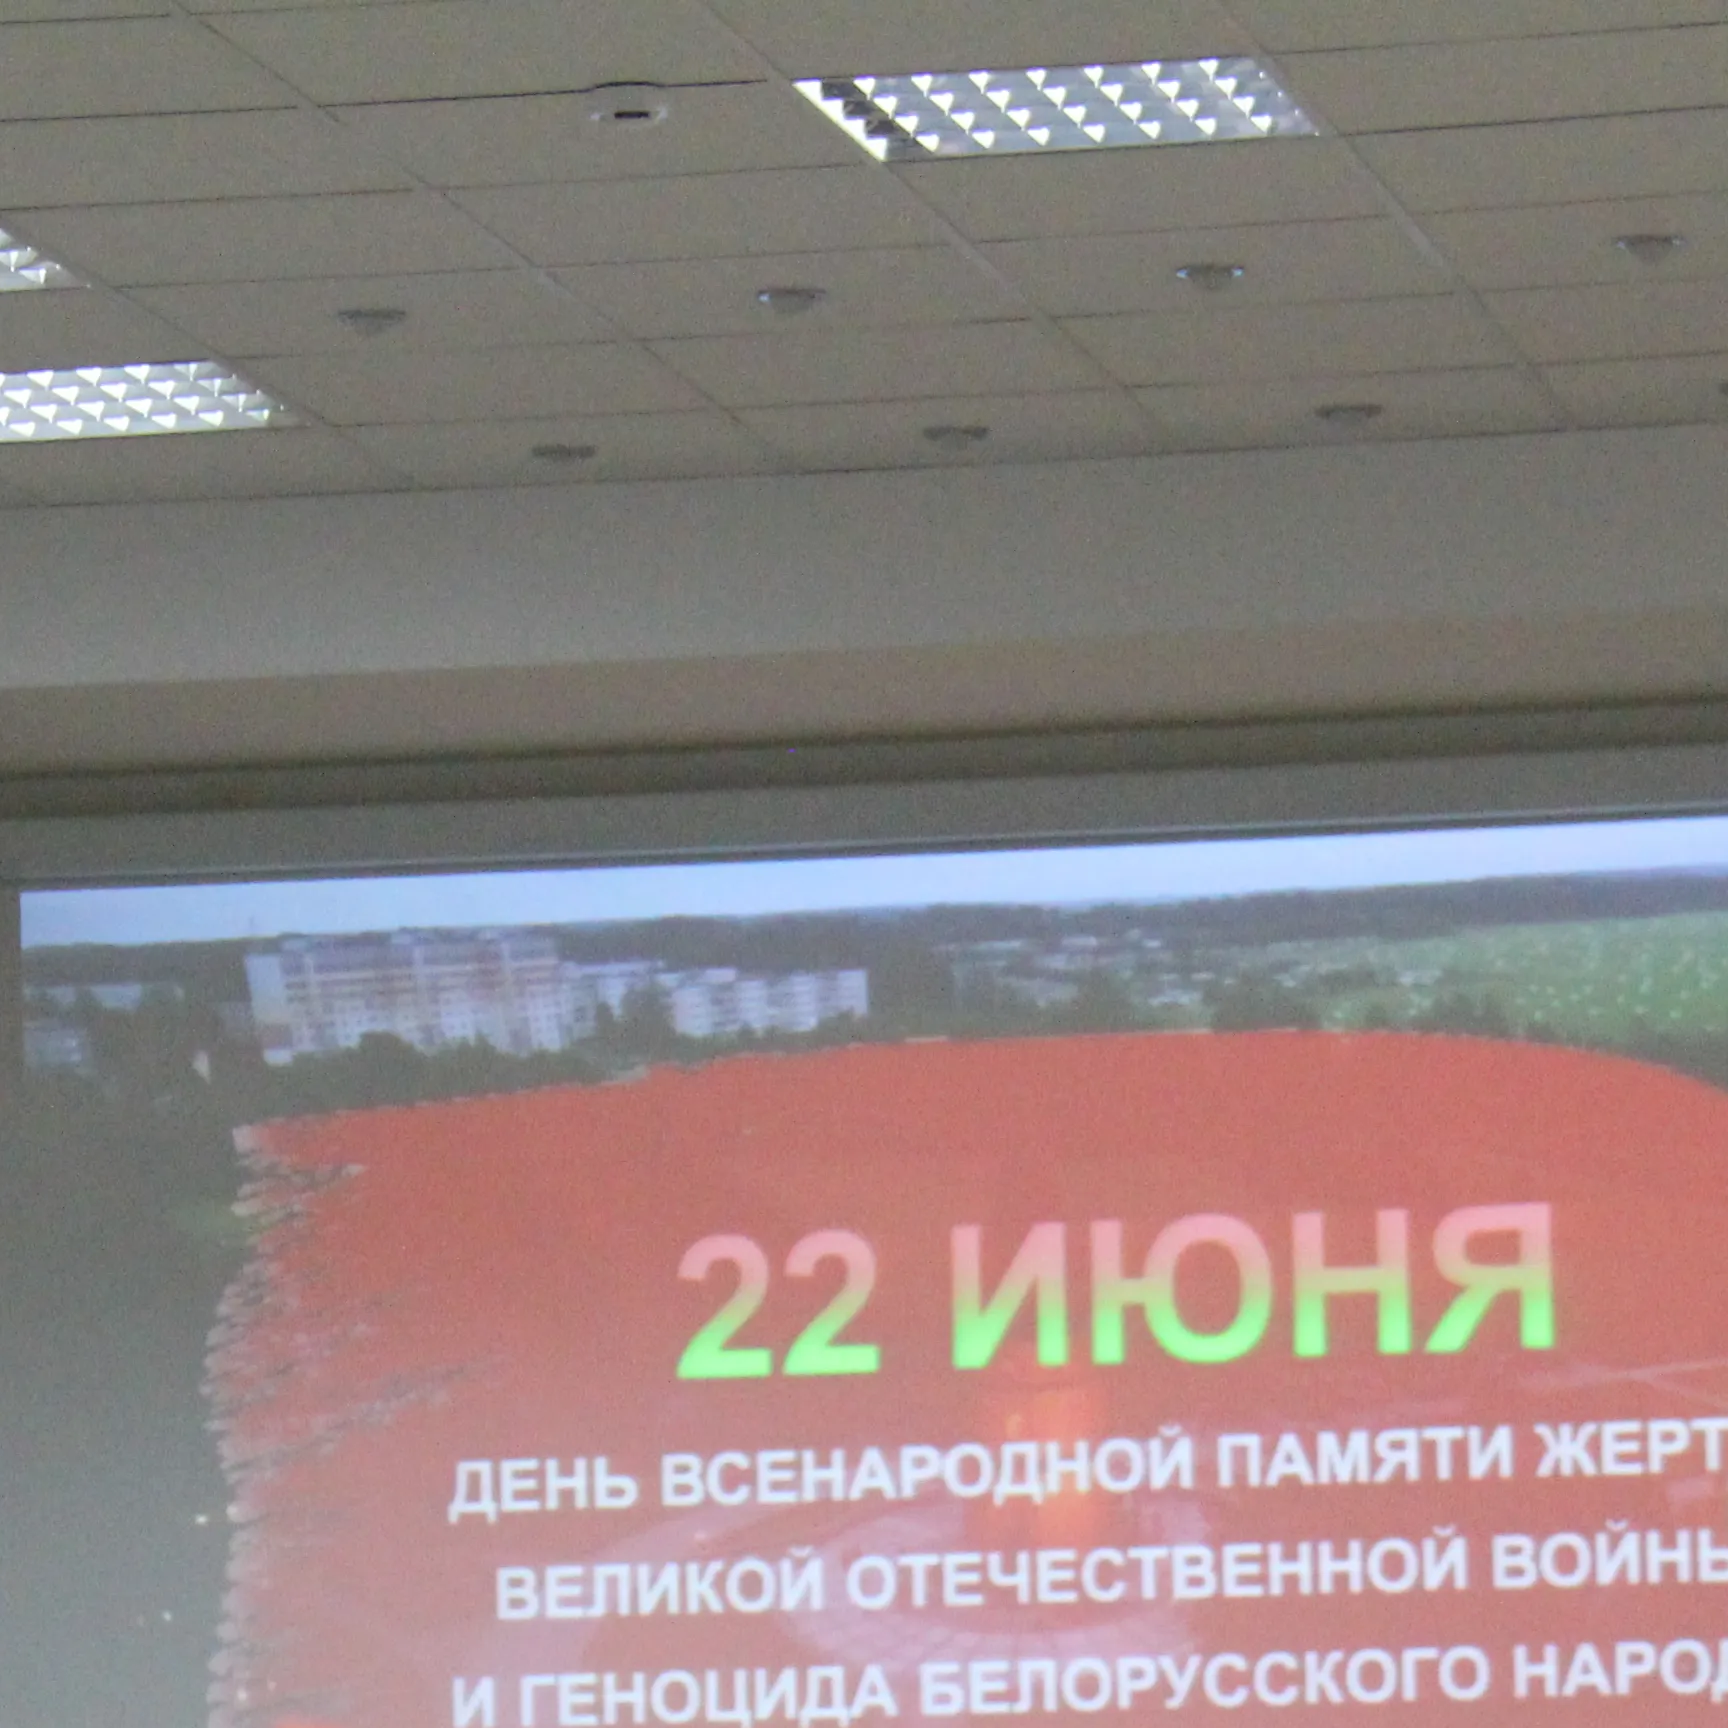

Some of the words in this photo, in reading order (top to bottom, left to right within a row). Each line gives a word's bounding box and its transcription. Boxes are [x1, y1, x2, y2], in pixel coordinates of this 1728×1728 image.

[674, 1231, 882, 1380] 22
[948, 1202, 1558, 1370] ИЮНЯ
[448, 1457, 640, 1522] ДЕНЬ
[660, 1424, 1196, 1507] ВСЕНАРОДНОЙ
[1215, 1423, 1515, 1489] ПАМЯТИ
[496, 1546, 825, 1620] ВЕЛИКОЙ
[845, 1524, 1469, 1610] ОТЕЧЕСТВЕННОЙ
[452, 1676, 496, 1728] И
[919, 1644, 1491, 1716] БЕЛОРУССКОГО
